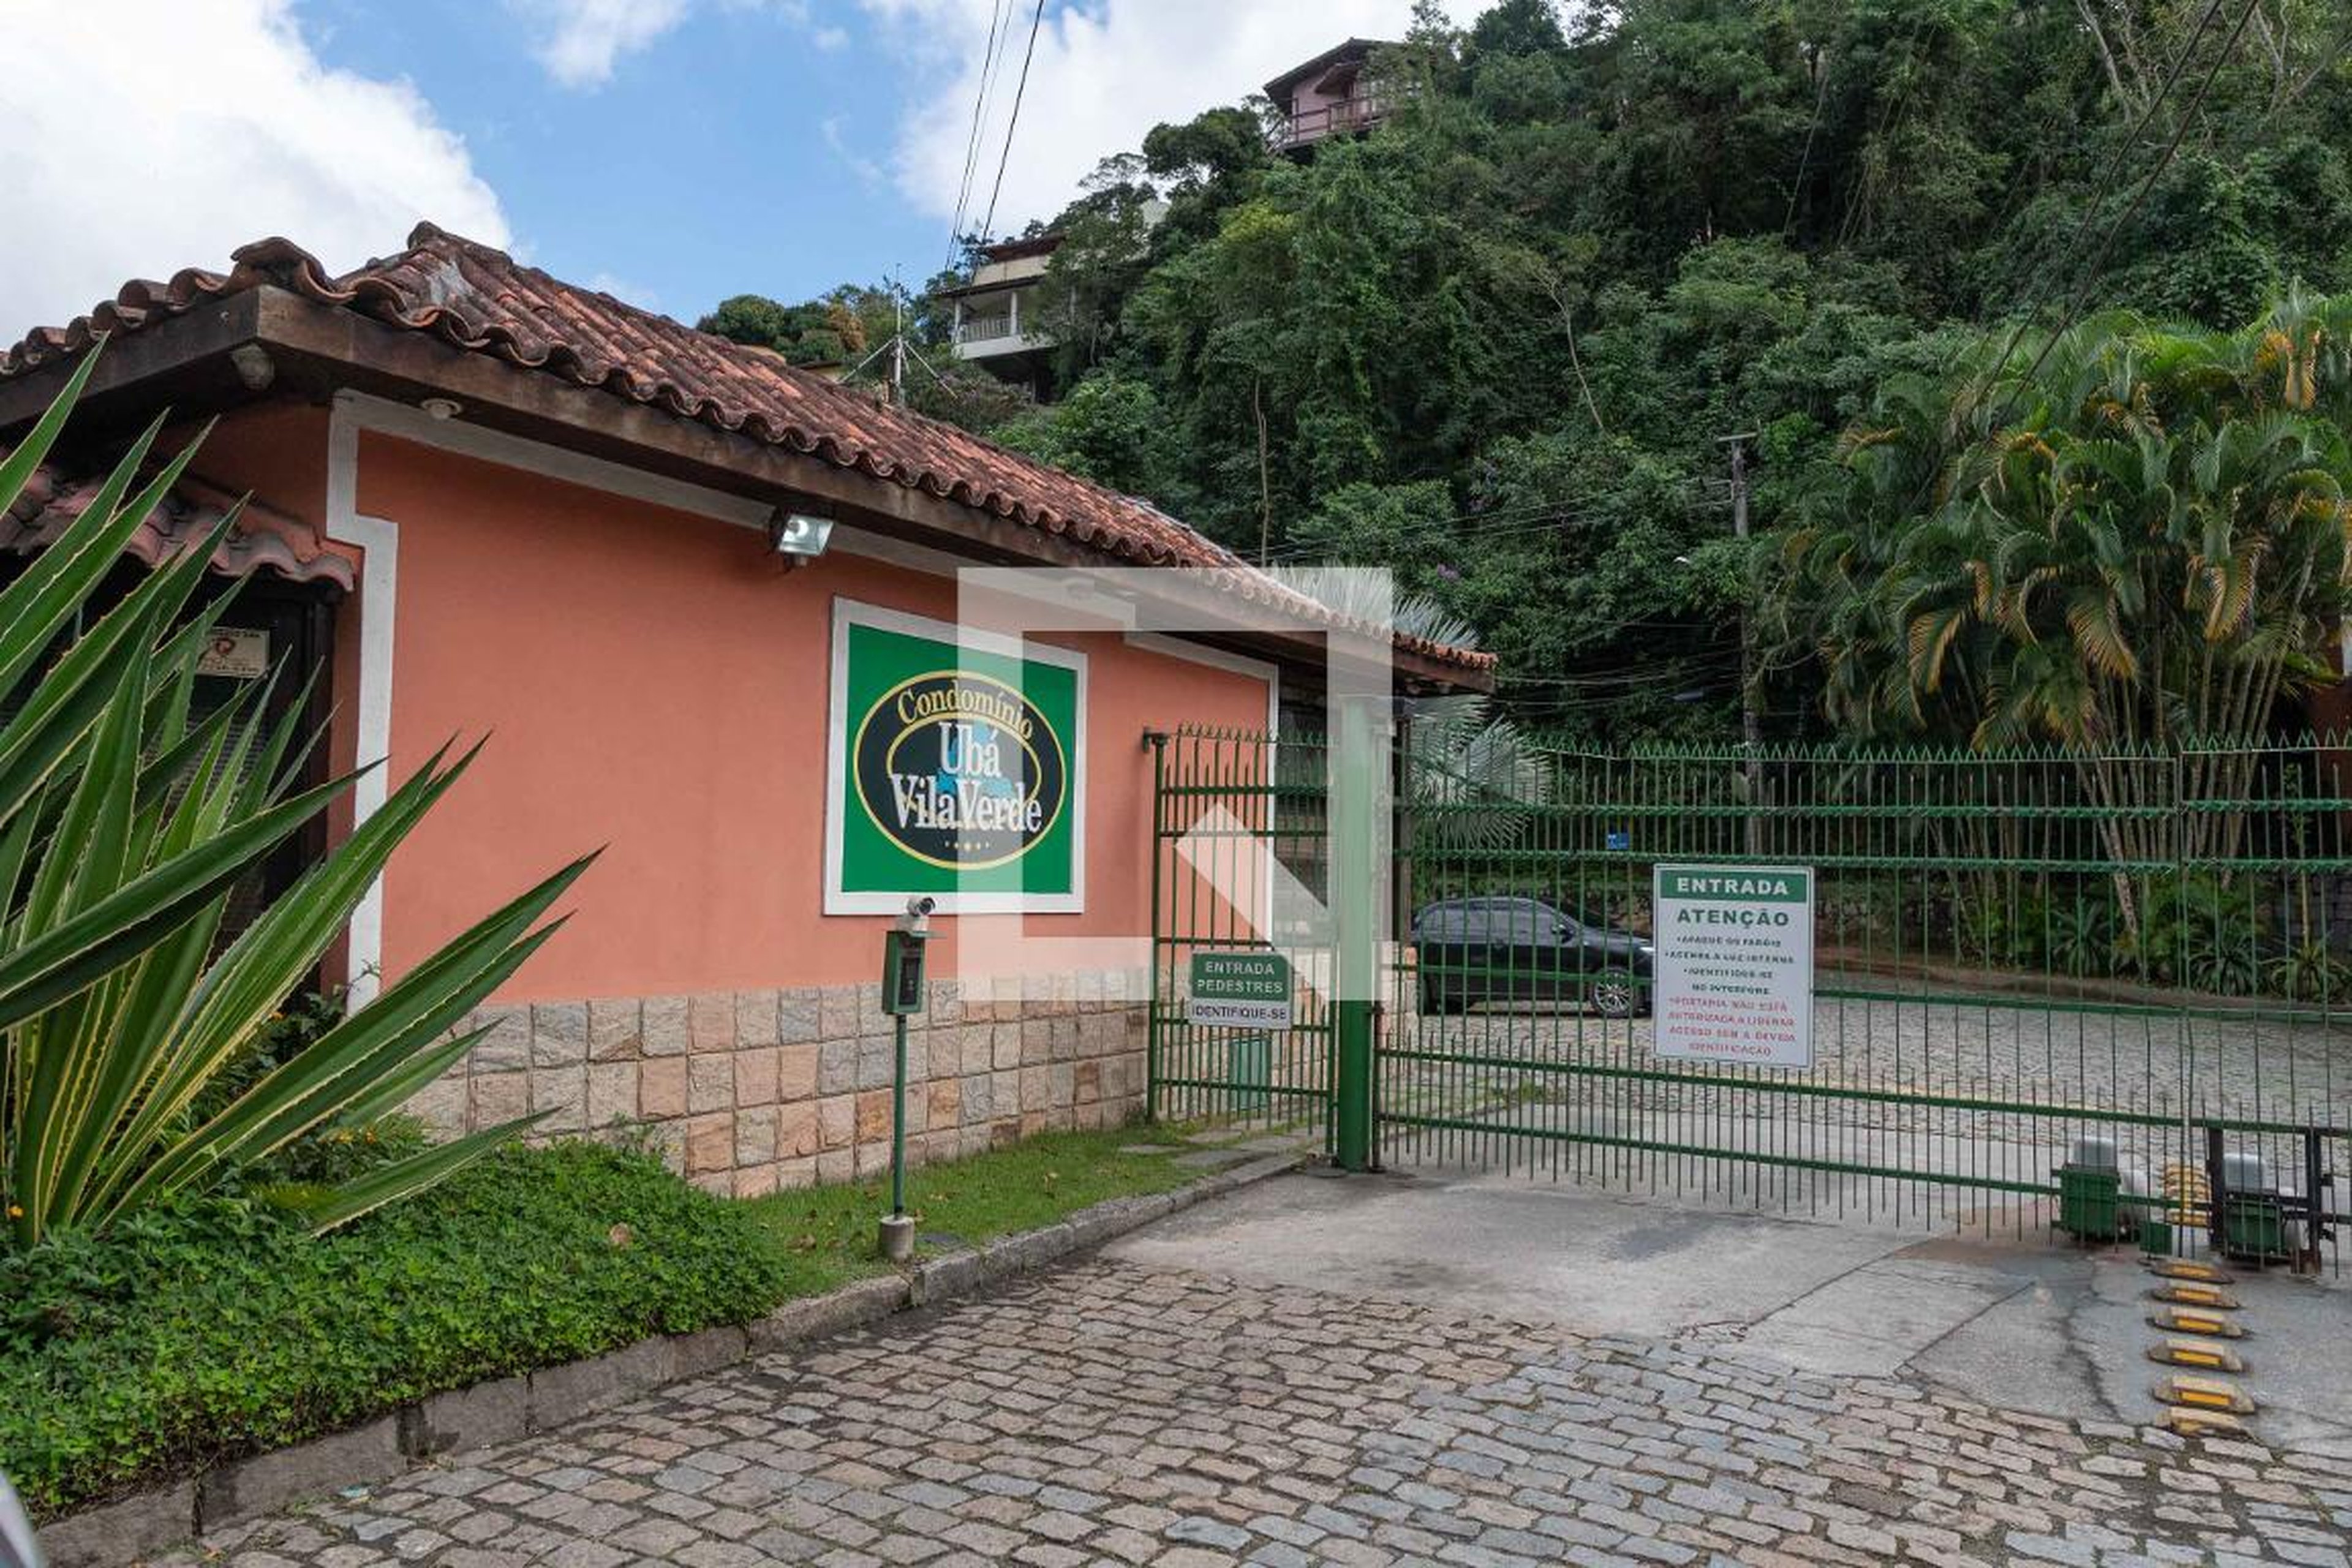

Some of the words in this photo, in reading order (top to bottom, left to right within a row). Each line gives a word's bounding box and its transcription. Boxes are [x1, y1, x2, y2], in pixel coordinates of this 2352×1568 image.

[897, 680, 1033, 741] Condomínio
[938, 722, 1002, 777] Ubá
[1676, 876, 1789, 895] ENTRADA
[1676, 908, 1790, 929] ATENÇÃO
[1205, 961, 1275, 974] ENTRADA
[1197, 979, 1283, 993] PEDESTRES
[1192, 1005, 1286, 1019] IDENTIFIQUE-SE
